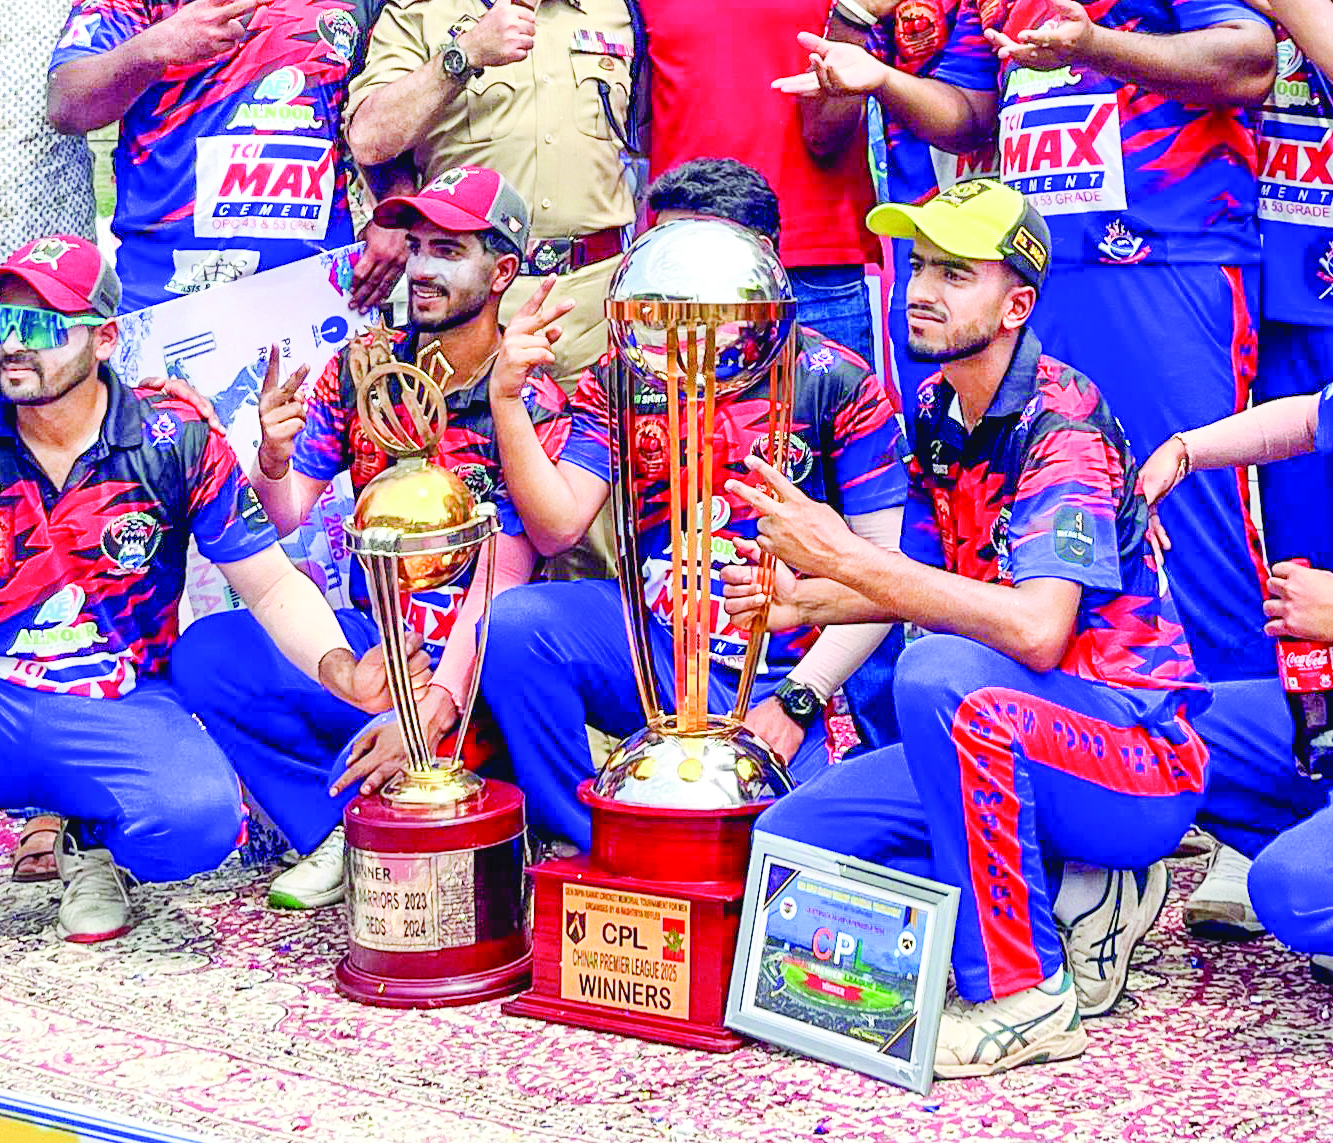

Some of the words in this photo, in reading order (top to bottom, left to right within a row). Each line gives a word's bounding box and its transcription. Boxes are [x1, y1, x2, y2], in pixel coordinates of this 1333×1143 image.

[1276, 81, 1310, 98] OOR
[236, 105, 317, 121] ALNOOR
[1004, 111, 1022, 130] TCI
[1004, 103, 1118, 177] MAX
[230, 143, 258, 159] TCI
[218, 148, 333, 200] MAX
[1040, 193, 1053, 207] 53
[1055, 190, 1102, 206] GRADE
[1261, 184, 1331, 203] MENT
[218, 203, 320, 218] CEMENT
[1271, 199, 1284, 213] 53
[1286, 203, 1331, 218] GRADE
[212, 218, 238, 230] OPC
[241, 218, 256, 229] 43
[260, 218, 269, 229] &
[272, 218, 287, 230] 53
[280, 338, 292, 358] Pay
[1286, 648, 1328, 669] Coca-Cola
[404, 892, 428, 910] 2023
[403, 919, 427, 938] 2024
[602, 922, 648, 950] CPL
[812, 926, 873, 973] CPL
[572, 948, 598, 969] CHINAR
[599, 953, 630, 975] PREMIER
[631, 957, 660, 980] LEAGUE
[661, 963, 678, 982] 2025
[579, 973, 672, 1011] WINNERS
